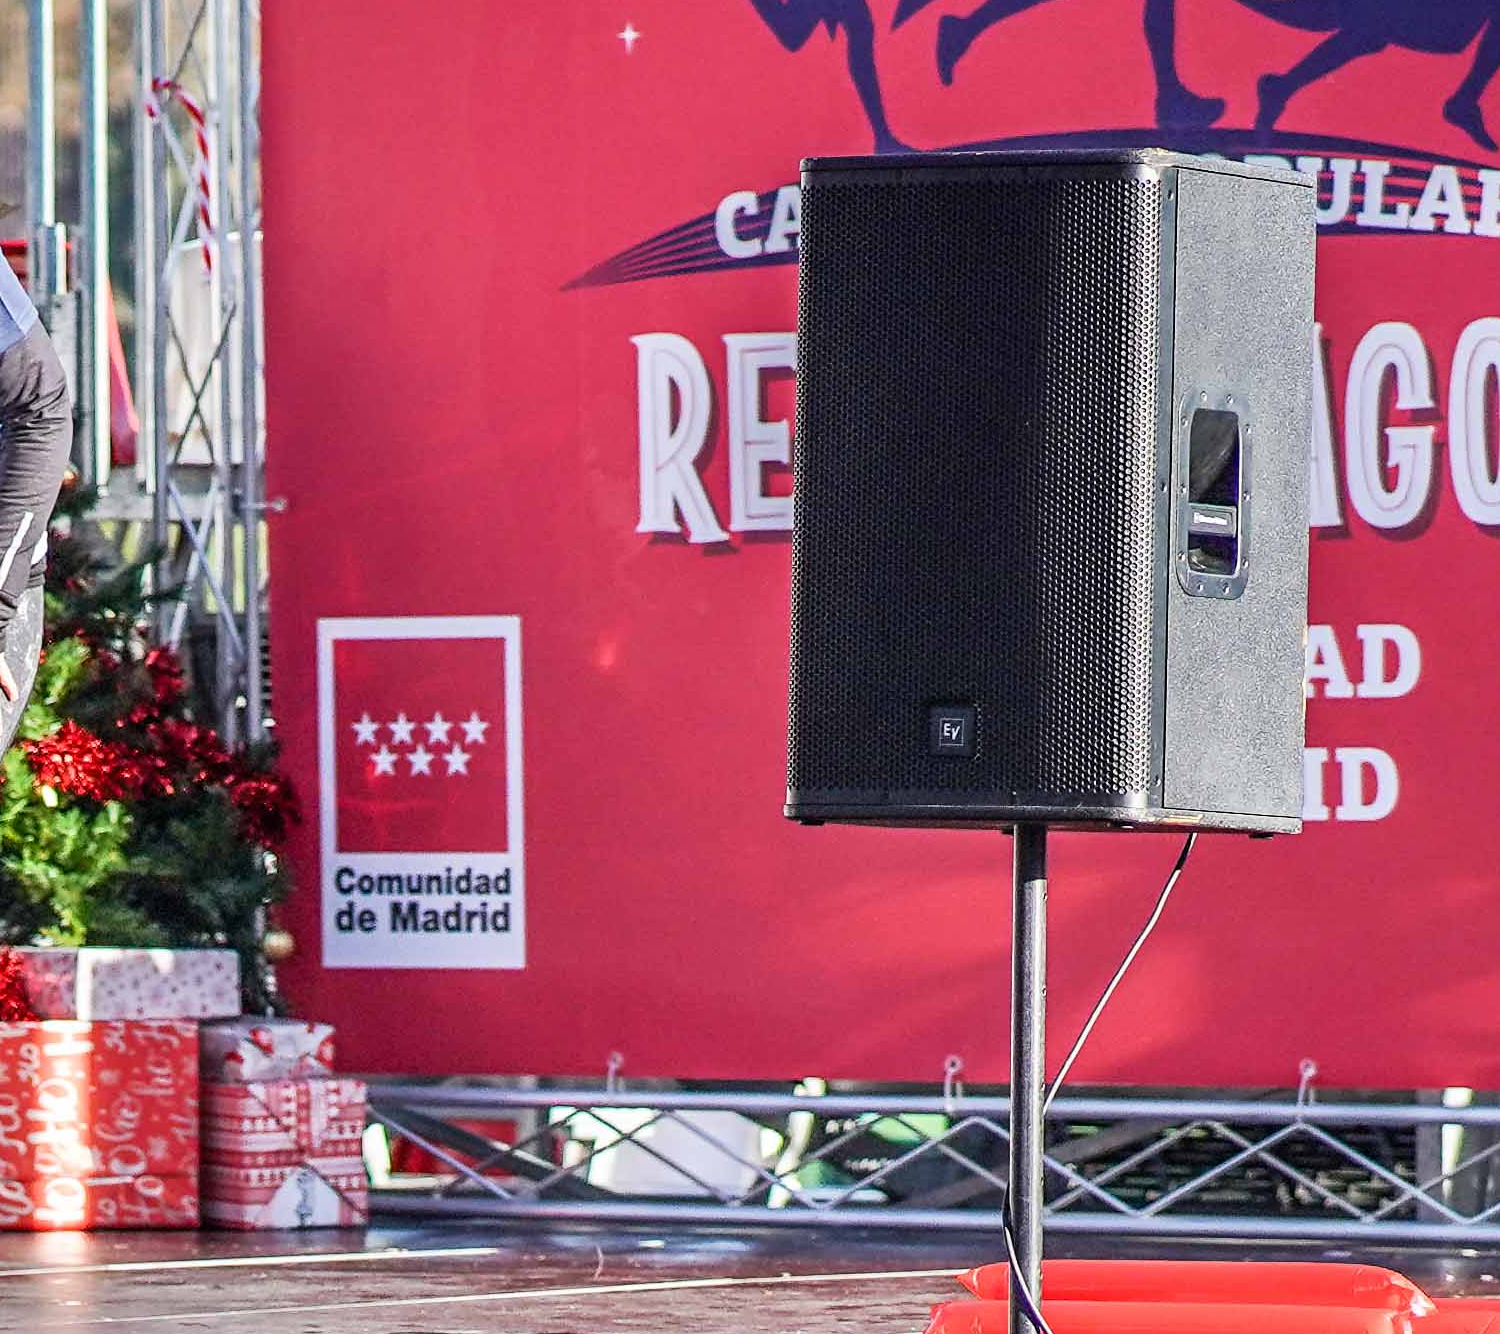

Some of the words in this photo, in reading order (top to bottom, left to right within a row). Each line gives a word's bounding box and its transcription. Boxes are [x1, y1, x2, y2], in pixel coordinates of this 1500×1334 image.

[335, 865, 512, 897] Comunidad
[335, 901, 377, 933] de
[390, 901, 512, 933] Madrid
